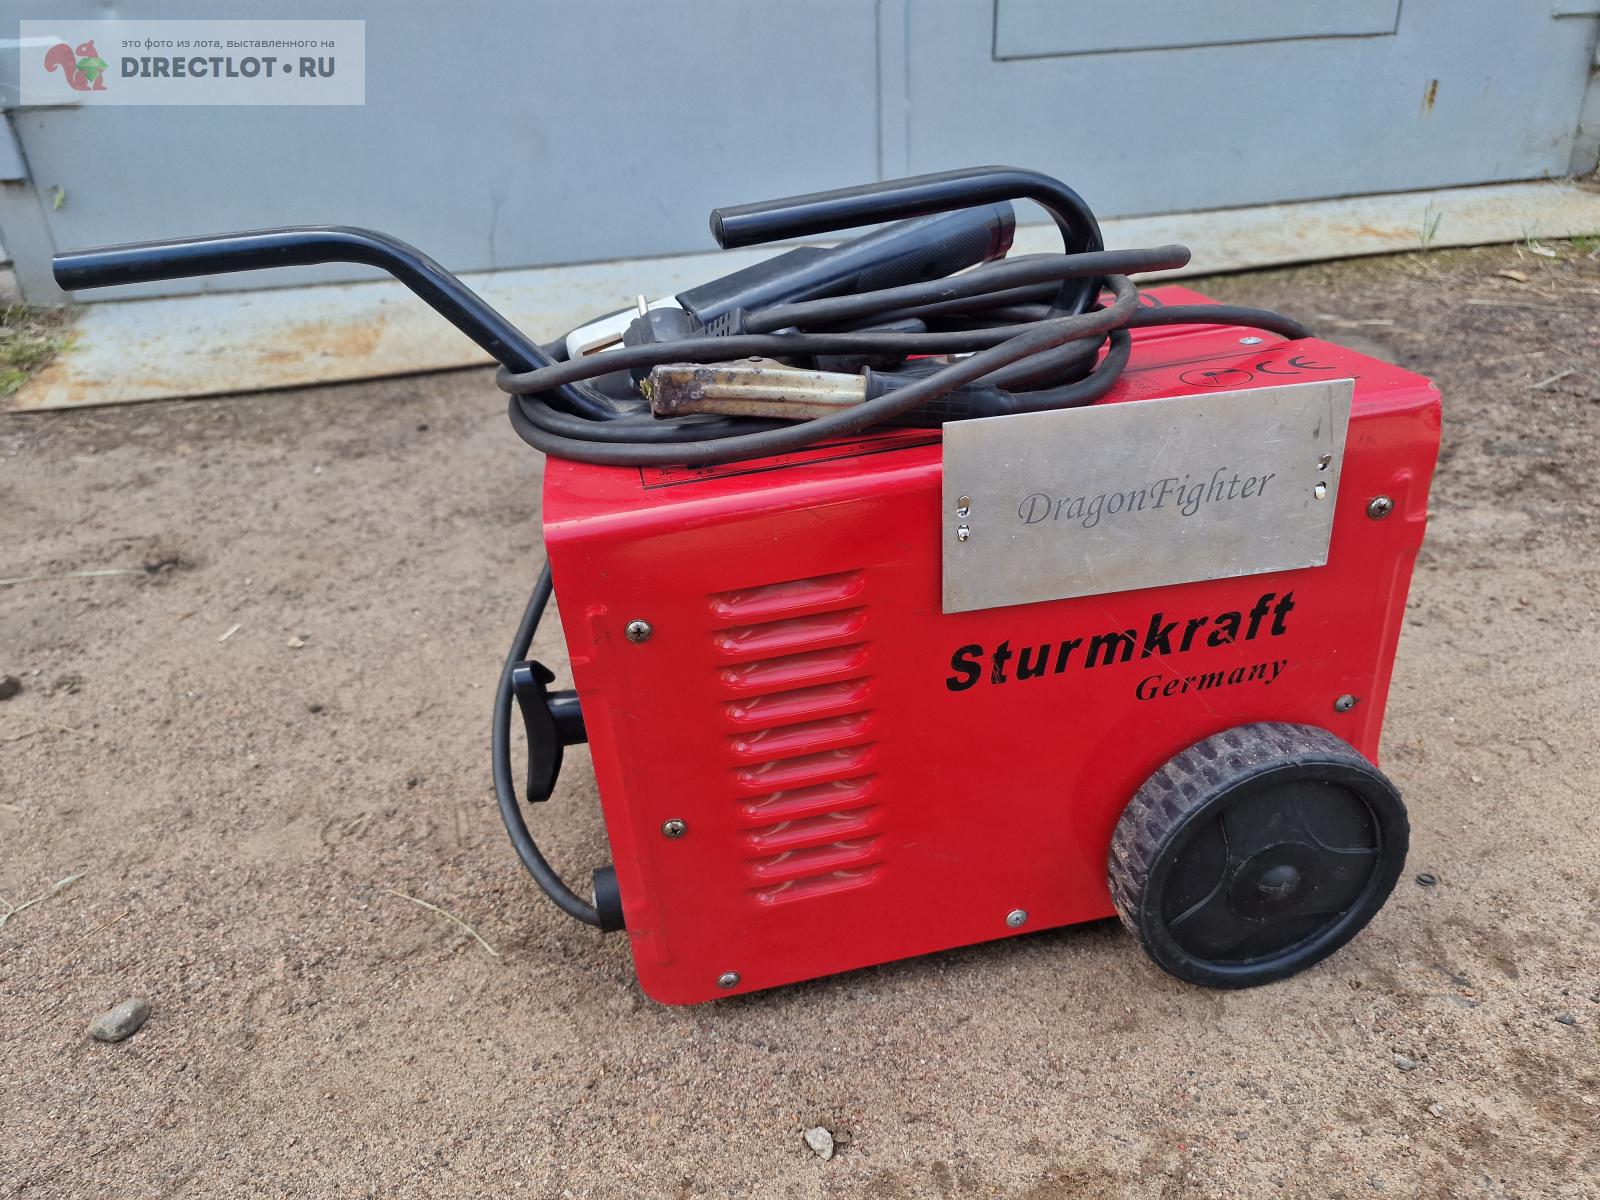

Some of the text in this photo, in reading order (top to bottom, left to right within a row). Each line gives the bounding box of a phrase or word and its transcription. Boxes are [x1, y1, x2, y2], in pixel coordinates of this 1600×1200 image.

[1018, 467, 1276, 528] DragonFighter
[946, 591, 1295, 692] Sturmkraft
[1136, 658, 1289, 701] Germany
